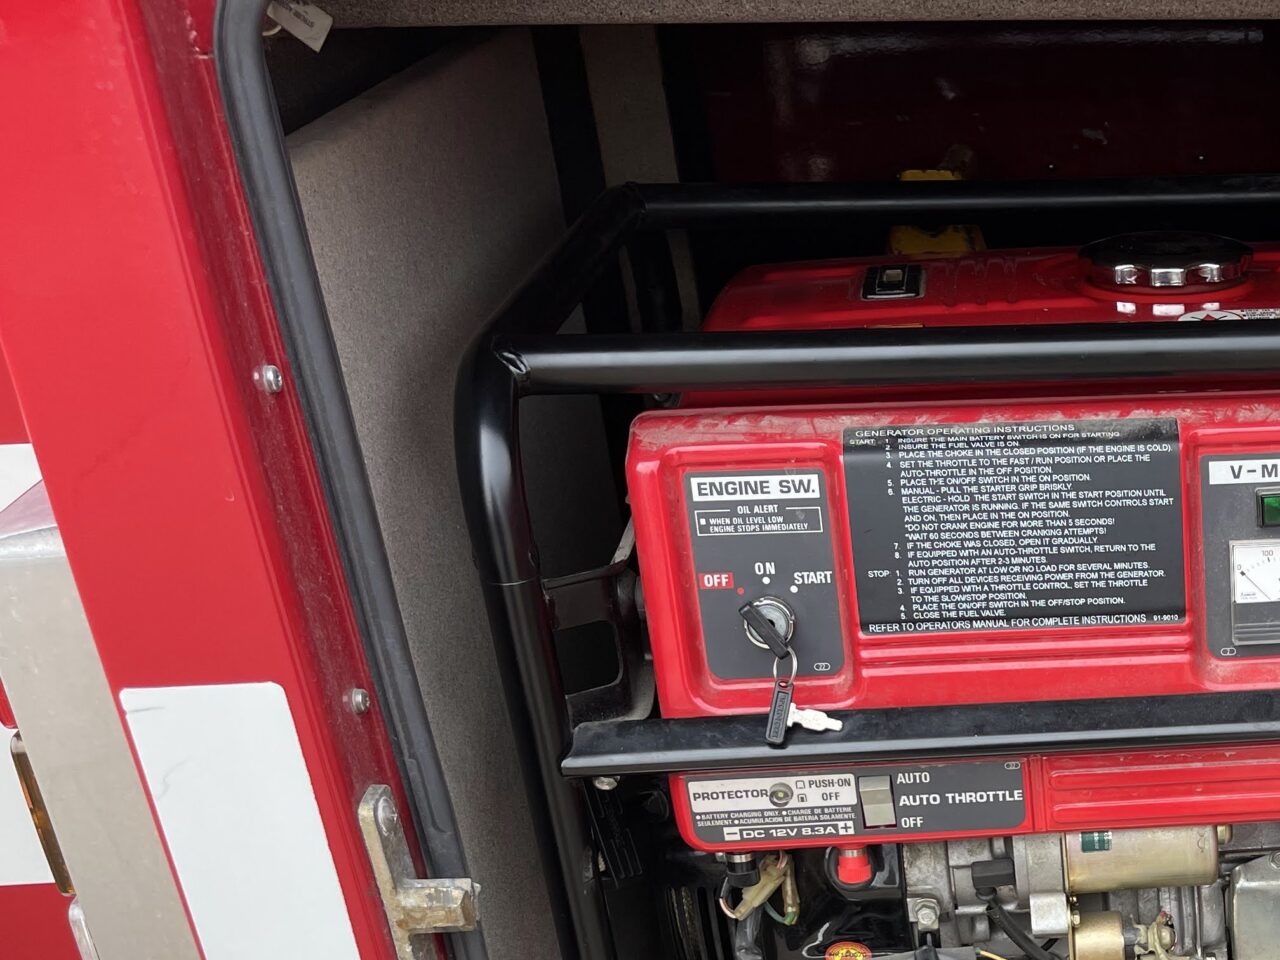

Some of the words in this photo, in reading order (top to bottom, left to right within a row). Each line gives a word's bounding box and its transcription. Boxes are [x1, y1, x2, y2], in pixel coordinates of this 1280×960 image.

[855, 429, 923, 437] GENERATOR
[927, 427, 990, 435] OPERATING
[993, 424, 1075, 433] INSTRUCTIONS
[898, 451, 925, 459] PLACE
[1002, 448, 1035, 456] CLOSED
[1036, 447, 1074, 455] POSITION
[1089, 446, 1103, 454] THE
[917, 460, 933, 468] THE
[935, 459, 977, 467] THROTTLE
[992, 458, 1007, 466] THE
[1009, 458, 1029, 466] FAST
[1035, 457, 1052, 465] RUN
[1054, 456, 1091, 464] POSITION
[1107, 455, 1132, 463] PLACE
[900, 469, 966, 478] AUTO-THROTTLE
[968, 468, 976, 476] IN
[978, 468, 994, 476] THE
[697, 481, 770, 496] ENGINE
[779, 479, 815, 494] SW.
[737, 505, 750, 514] OIL
[754, 504, 778, 513] ALERT
[710, 525, 735, 533] ENGINE
[762, 523, 808, 531] IMMEDIATELY
[921, 523, 938, 531] NOT
[940, 522, 967, 530] CRANK
[969, 521, 999, 529] ENGINE
[1019, 520, 1043, 528] MORE
[1045, 519, 1066, 527] THAN
[1068, 519, 1073, 527] 5
[1074, 518, 1116, 526] SECONDS!
[929, 532, 938, 540] 60
[940, 531, 979, 540] SECONDS
[980, 530, 1019, 538] BETWEEN
[1020, 529, 1062, 537] CRANKING
[1063, 527, 1107, 536] ATTEMPTS!
[755, 562, 775, 574] ON
[927, 567, 975, 576] GENERATOR
[988, 566, 1007, 574] LOW
[1022, 565, 1034, 573] NO
[1035, 565, 1057, 573] LOAD
[1058, 564, 1075, 572] FOR
[1076, 563, 1111, 571] SEVERAL
[704, 574, 728, 587] OFF
[794, 571, 832, 584] START
[908, 577, 929, 585] TURN
[931, 576, 947, 584] OFF
[948, 576, 962, 584] ALL
[964, 575, 998, 583] DEVICES
[1000, 574, 1043, 582] RECEIVING
[1044, 573, 1073, 581] POWER
[1075, 572, 1098, 580] FROM
[913, 611, 939, 619] CLOSE
[941, 611, 957, 619] THE
[958, 610, 979, 618] FUEL
[869, 623, 899, 633] REFER
[902, 623, 914, 631] TO
[915, 620, 970, 631] OPERATORS
[972, 619, 1008, 629] MANUAL
[1011, 618, 1029, 627] FOR
[1031, 616, 1079, 627] COMPLETE
[1081, 614, 1147, 625] INSTRUCTIONS
[809, 778, 851, 788] PUSH-ON
[897, 772, 930, 784] AUTO
[693, 789, 768, 801] PROTECTOR
[822, 792, 840, 801] OFF
[899, 794, 940, 806] AUTO
[946, 790, 1023, 803] THROTTLE
[902, 817, 923, 828] OFF
[742, 830, 765, 838] DC
[769, 828, 797, 837] 12V
[802, 826, 836, 836] 8.3A
